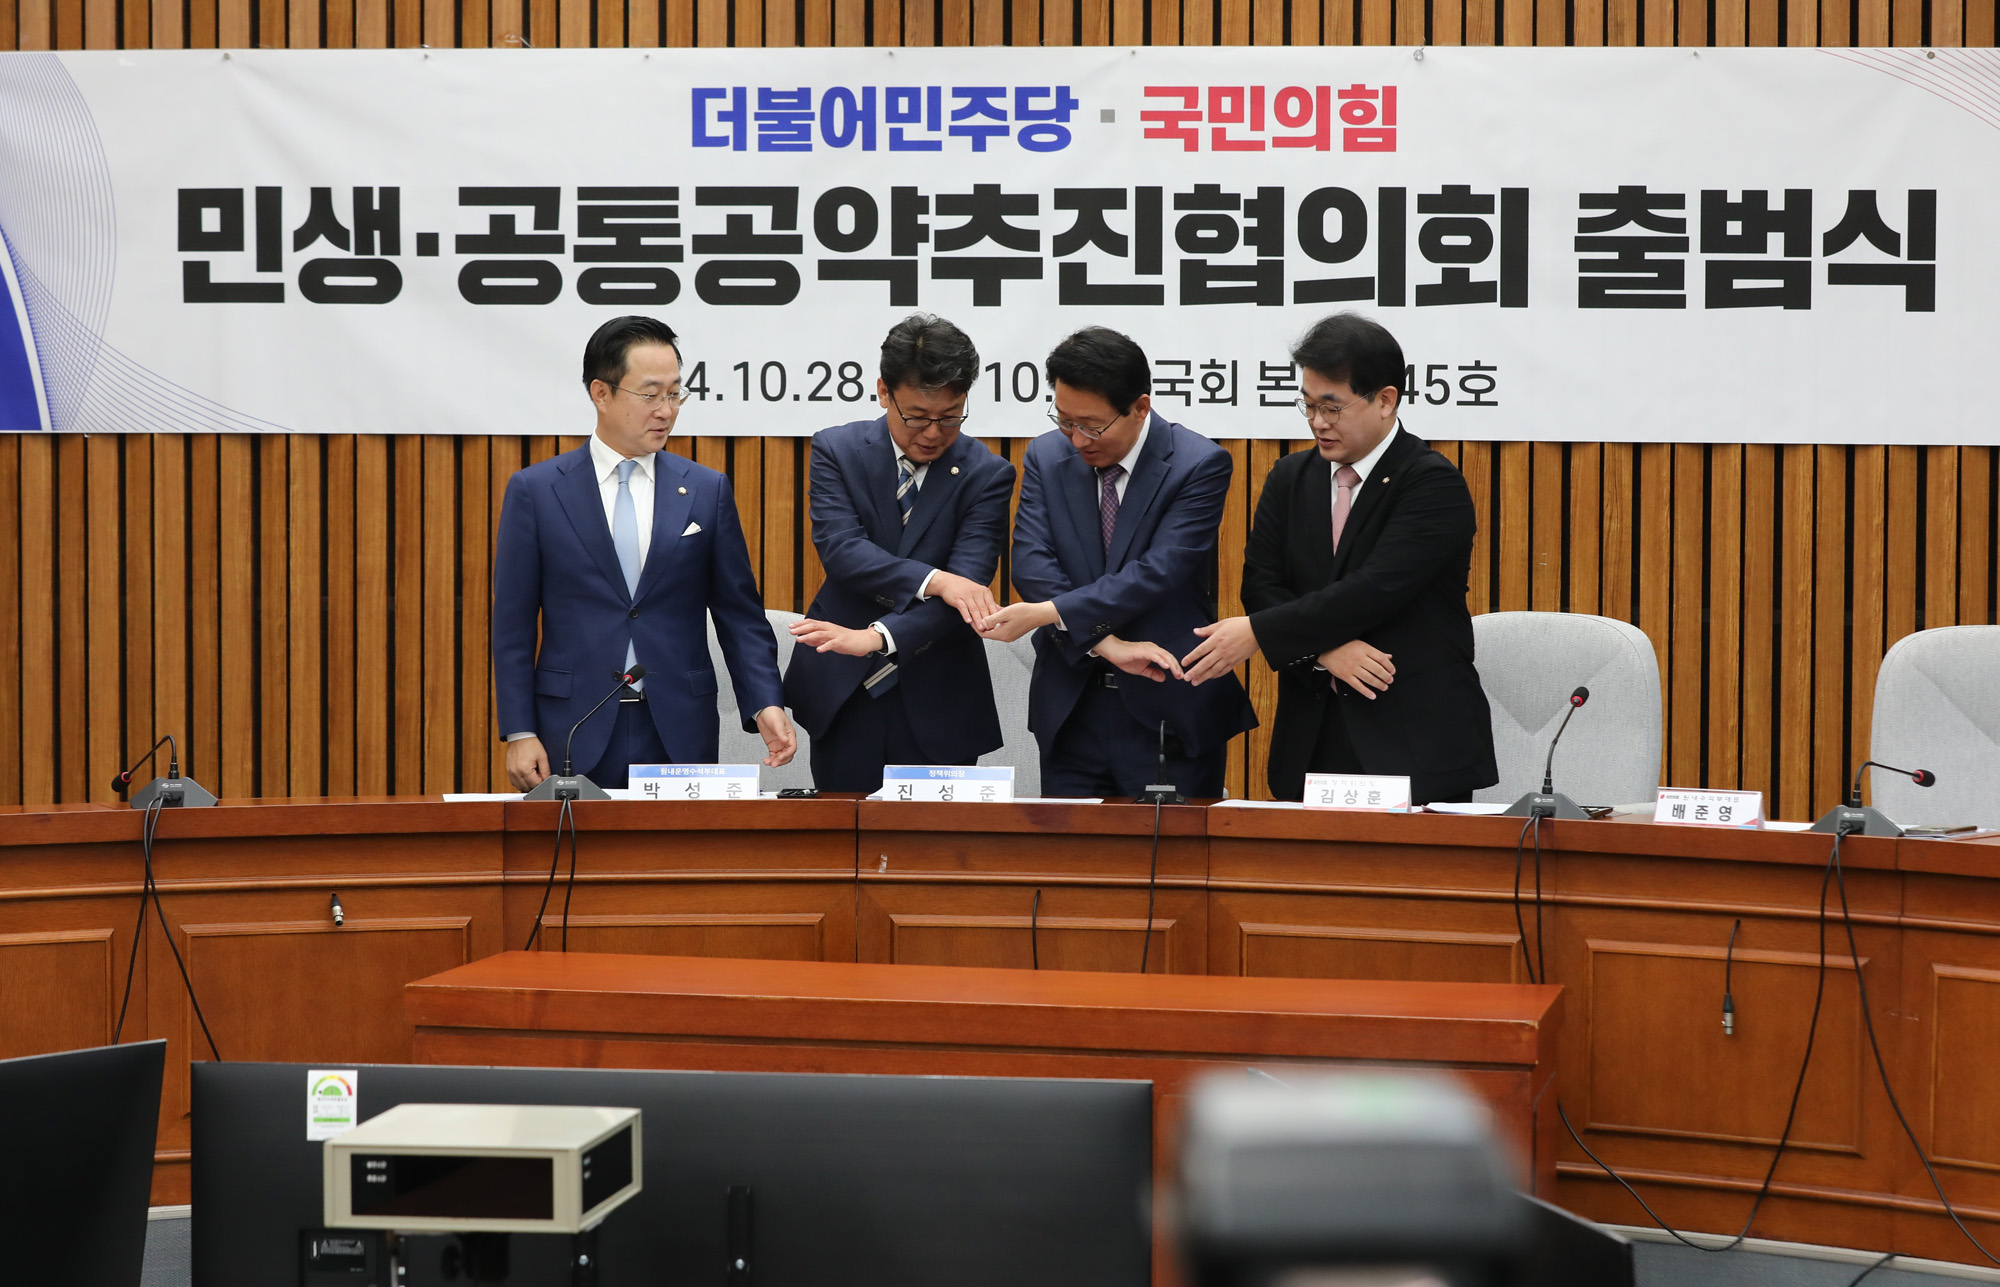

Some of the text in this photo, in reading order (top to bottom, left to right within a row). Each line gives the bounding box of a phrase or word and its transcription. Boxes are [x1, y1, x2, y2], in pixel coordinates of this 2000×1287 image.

[692, 86, 1079, 153] 더불어민주당
[1141, 84, 1397, 152] 국민의힘
[178, 184, 1937, 312] 민생·공통공약추진협의회 출범식
[684, 361, 878, 402] 4.10.28.
[1153, 359, 1237, 406] 국회
[1257, 360, 1299, 406] 본
[1402, 360, 1498, 406] 45호
